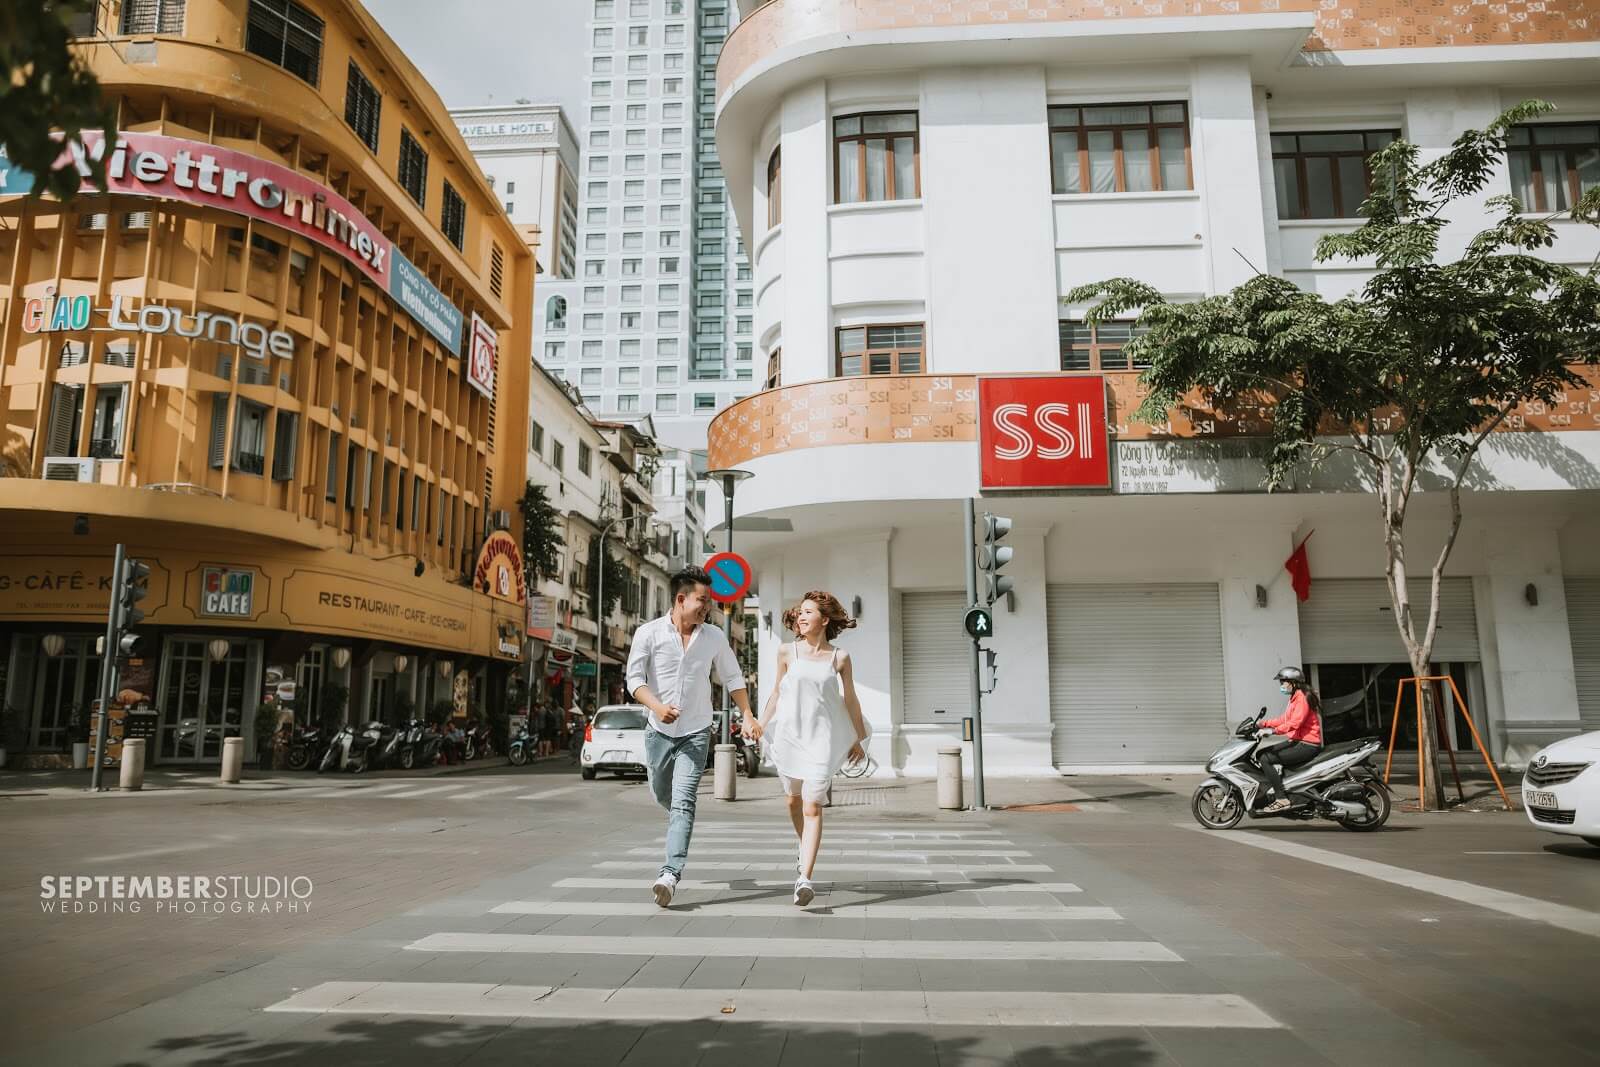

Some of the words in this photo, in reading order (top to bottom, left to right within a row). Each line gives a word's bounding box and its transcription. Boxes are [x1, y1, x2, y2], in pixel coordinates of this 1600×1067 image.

[1488, 4, 1507, 15] SSI
[1527, 2, 1546, 13] SSI
[1509, 12, 1528, 23] SSI
[460, 124, 505, 135] AVELLE
[511, 123, 550, 133] HOTEL
[70, 139, 386, 273] Viettronimex
[420, 283, 428, 297] TY
[108, 294, 294, 360] Lounge
[932, 378, 953, 390] SSI
[870, 391, 889, 403] SSI
[955, 389, 976, 401] SSI
[890, 403, 911, 415] SSI
[1525, 402, 1545, 415] SSI
[1570, 401, 1591, 414] SSI
[1549, 414, 1570, 426] SSI
[933, 425, 954, 438] SSI
[992, 402, 1092, 461] SSI
[1194, 421, 1214, 433] SSI
